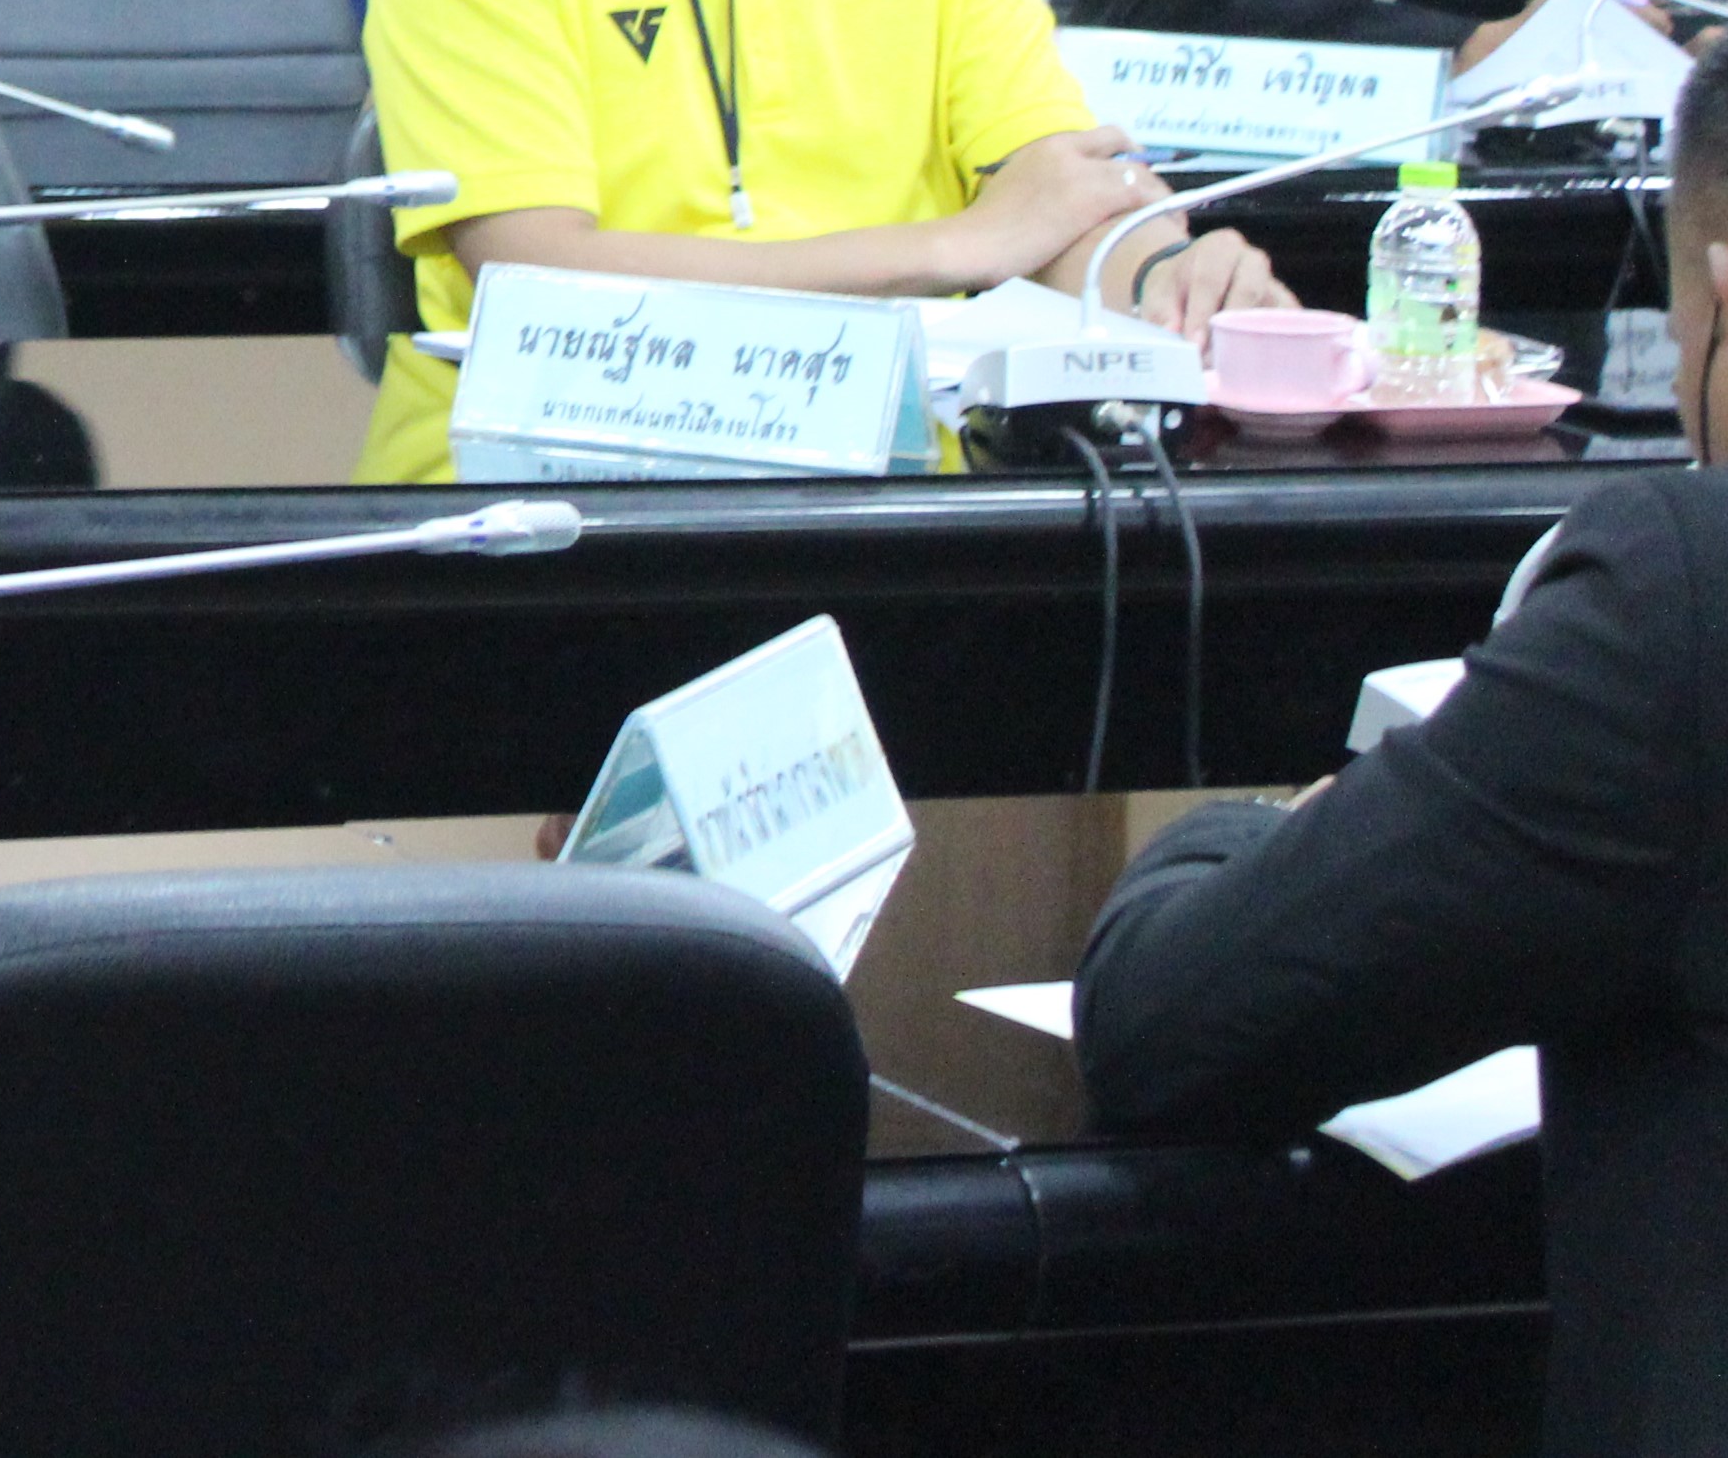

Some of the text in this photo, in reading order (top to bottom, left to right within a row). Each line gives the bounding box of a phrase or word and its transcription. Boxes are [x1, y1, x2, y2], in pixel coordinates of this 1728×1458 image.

[517, 292, 853, 407] นายณัฐพล นาคสุข
[1063, 349, 1155, 375] NPE
